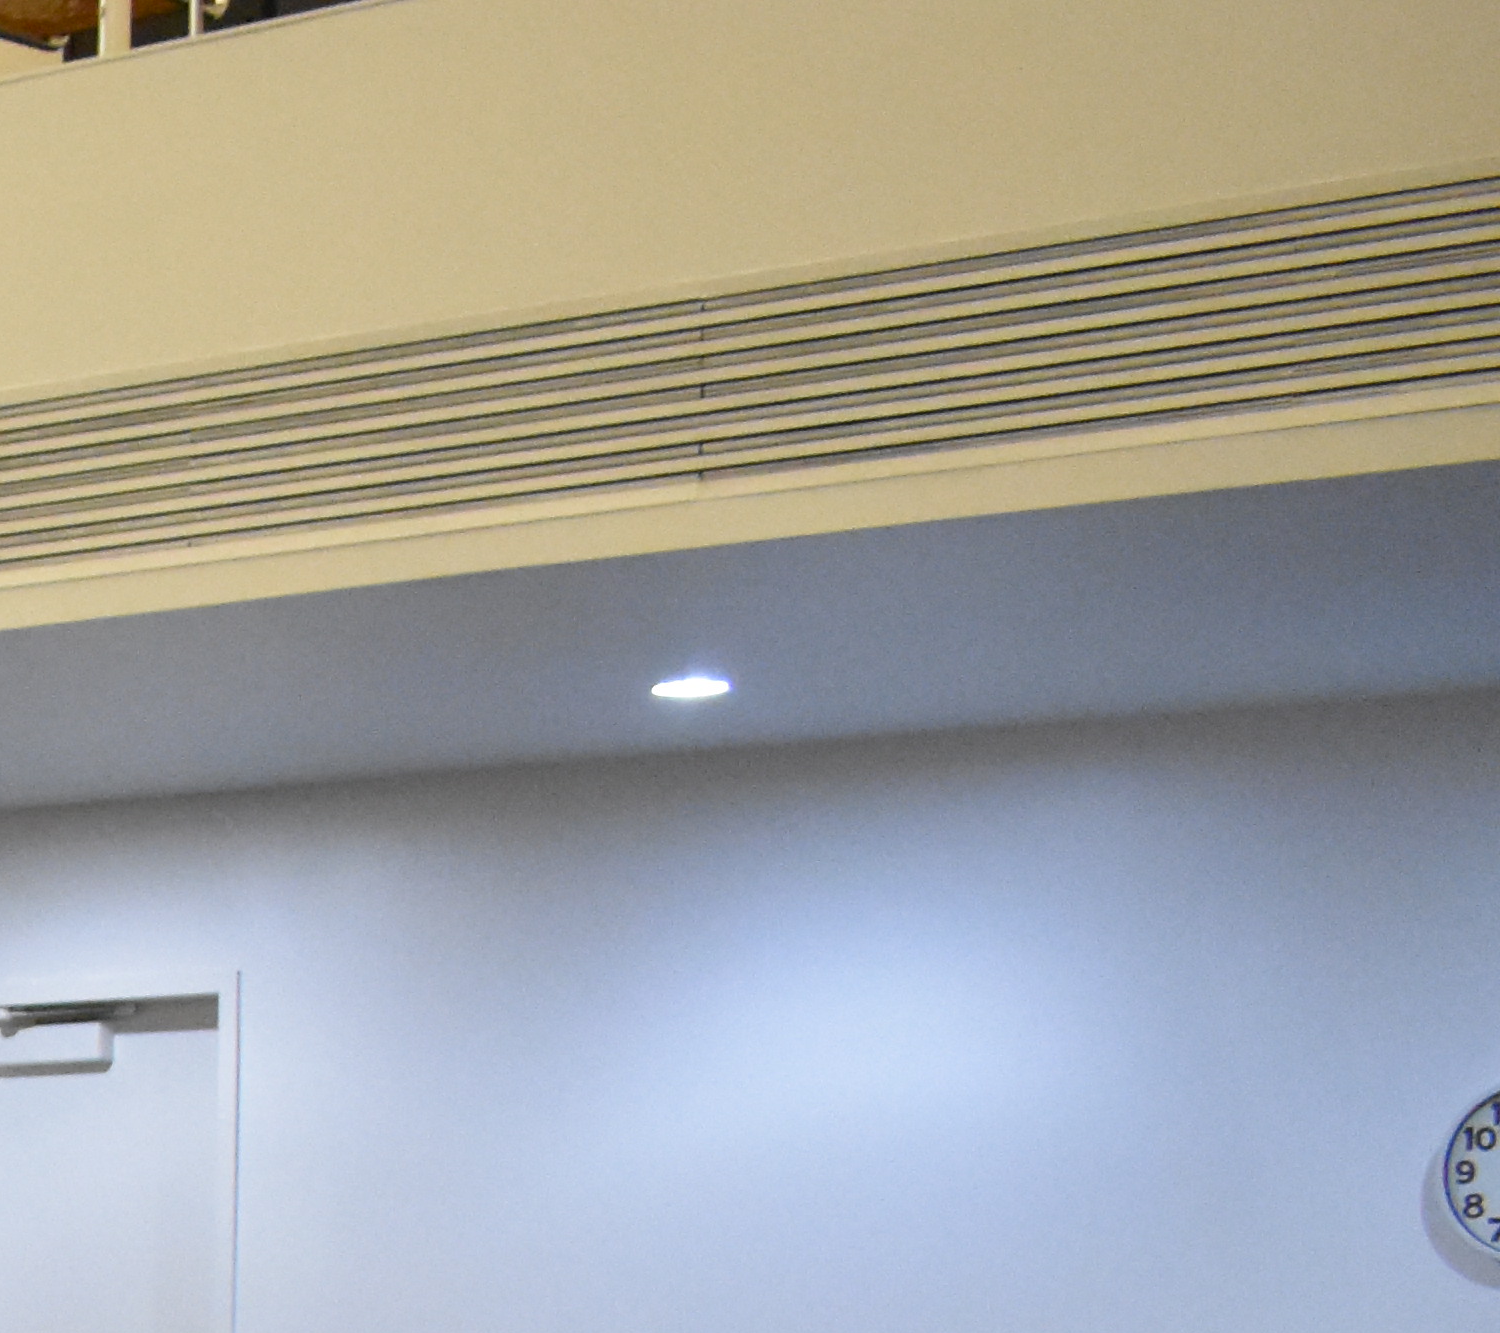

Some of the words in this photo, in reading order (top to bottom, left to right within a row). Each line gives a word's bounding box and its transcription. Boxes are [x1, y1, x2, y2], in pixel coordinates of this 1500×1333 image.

[1462, 1126, 1496, 1153] 10
[1455, 1160, 1475, 1186] 9
[1462, 1193, 1485, 1219] 8
